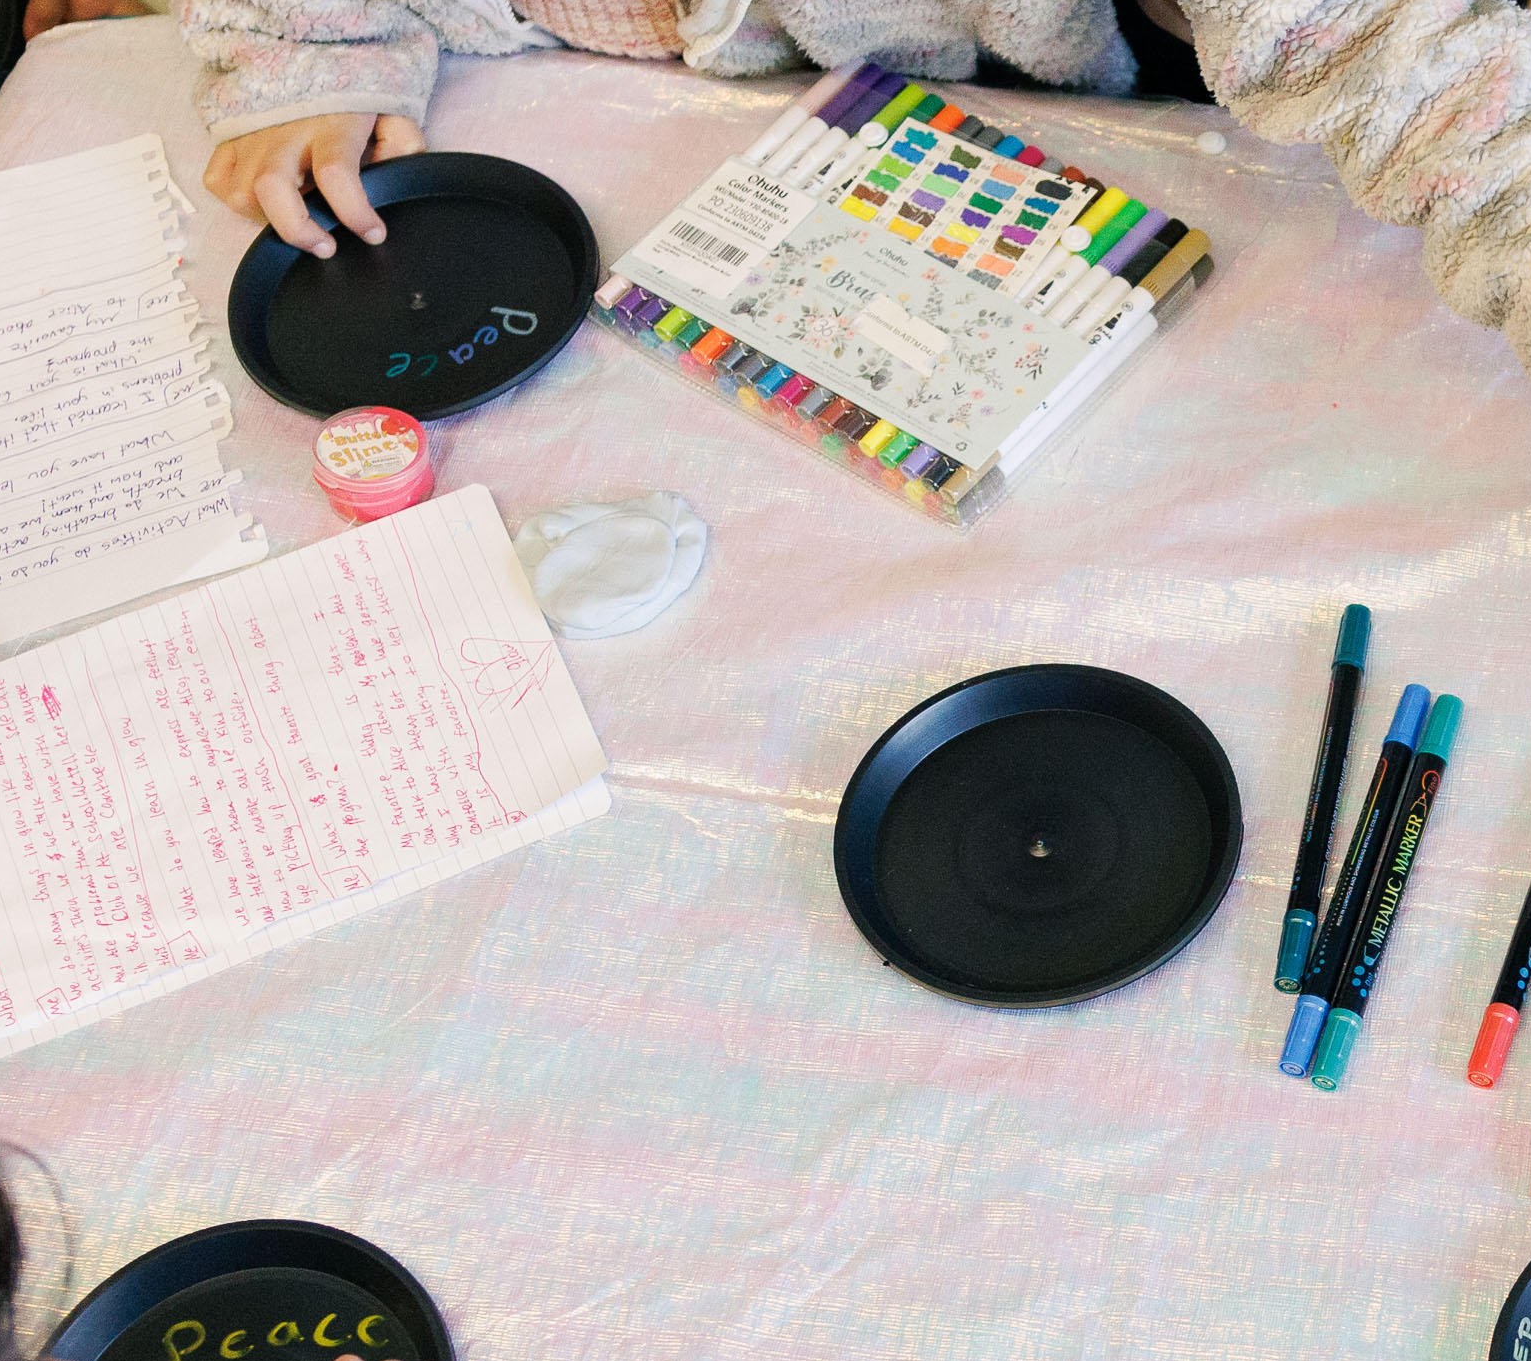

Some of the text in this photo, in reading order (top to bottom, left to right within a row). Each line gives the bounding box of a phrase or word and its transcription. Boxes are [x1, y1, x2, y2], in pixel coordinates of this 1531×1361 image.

[728, 178, 788, 214] Color Markers
[747, 174, 789, 199] Ohuhu
[879, 247, 908, 267] Ohuhu
[106, 297, 125, 307] to
[814, 320, 833, 337] 36
[386, 306, 538, 378] Peace
[72, 365, 85, 374] is
[95, 355, 137, 376] What
[121, 359, 182, 388] problems
[54, 389, 87, 410] your
[101, 387, 113, 396] in
[24, 421, 57, 442] that
[27, 430, 173, 479] What have you
[154, 454, 182, 472] and
[329, 440, 399, 468] Slime
[110, 470, 141, 484] how
[122, 468, 182, 497] breath
[88, 493, 113, 508] and
[197, 497, 228, 519] What
[18, 516, 41, 529] we
[41, 508, 116, 535] breathing
[32, 548, 58, 568] you
[74, 546, 90, 557] do
[10, 566, 27, 577] do
[345, 694, 358, 705] is
[267, 804, 286, 819] up
[165, 828, 180, 847] you
[400, 830, 418, 847] My
[170, 857, 182, 871] do
[1368, 813, 1424, 950] METALLIC MARKER
[180, 887, 197, 920] What
